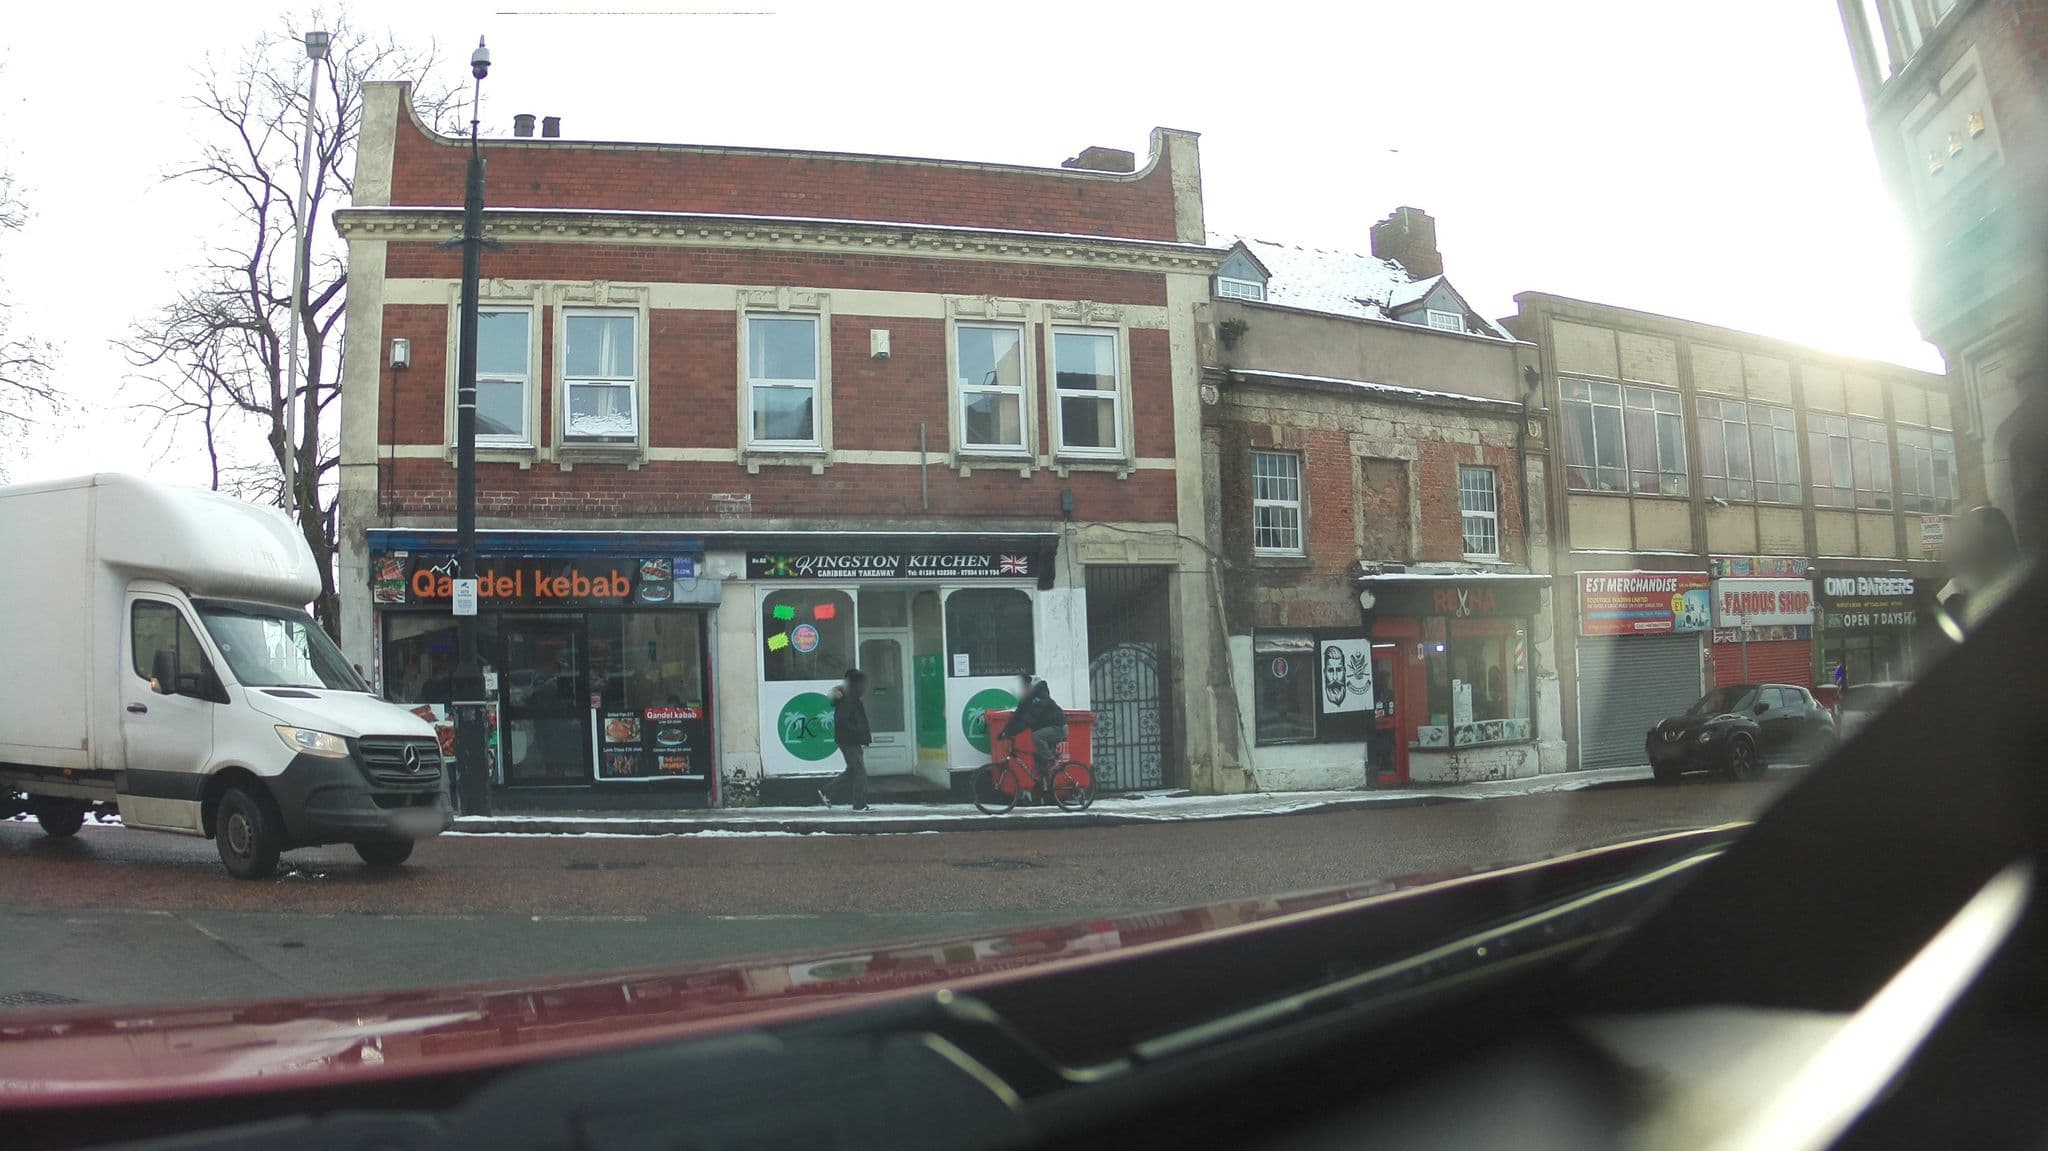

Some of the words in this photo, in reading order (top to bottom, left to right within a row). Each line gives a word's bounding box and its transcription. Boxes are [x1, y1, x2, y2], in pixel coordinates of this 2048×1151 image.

[795, 555, 900, 576] KINGSTON
[908, 555, 991, 568] KITCHEN
[817, 569, 857, 577] CARIBBEAN
[859, 569, 896, 577] TAKEAWAY
[412, 568, 522, 598] Qadel
[535, 568, 631, 598] kebab
[1585, 578, 1606, 593] EST
[1606, 578, 1678, 593] MERCHANDISE
[1857, 577, 1914, 596] BARBERS
[1723, 591, 1777, 616] FAMOUS
[1778, 590, 1809, 615] SHOP
[1843, 614, 1870, 627] OPEN
[1873, 614, 1880, 625] 7
[1881, 612, 1904, 625] DAYS
[646, 711, 673, 719] Qandel
